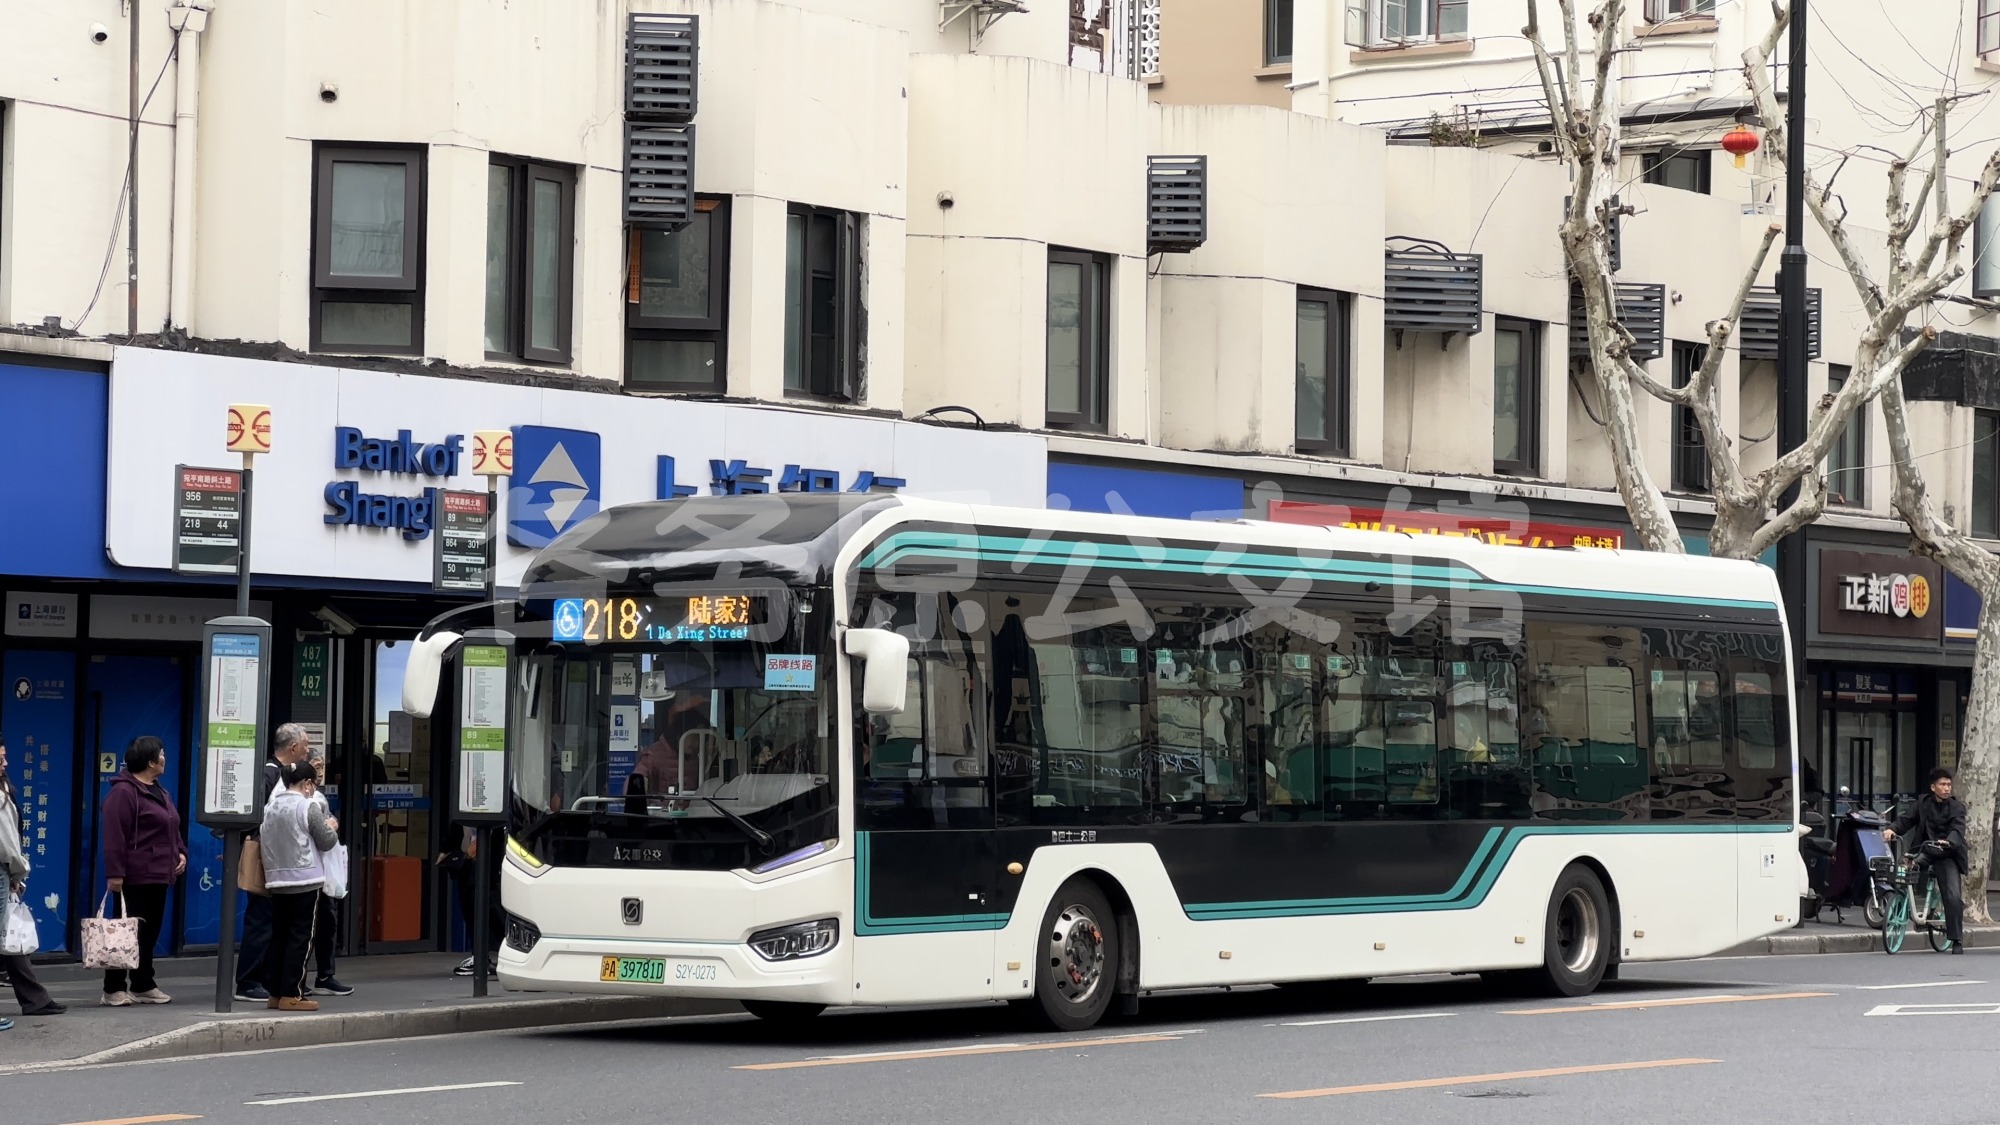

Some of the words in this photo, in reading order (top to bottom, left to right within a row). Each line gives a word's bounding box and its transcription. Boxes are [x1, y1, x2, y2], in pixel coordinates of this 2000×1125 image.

[335, 426, 424, 474] Bank
[421, 434, 464, 477] of
[183, 474, 231, 484] 宛平南路斜土路
[185, 491, 201, 501] 956
[323, 481, 438, 541] Shang
[184, 518, 200, 528] 218
[216, 520, 229, 530] 44
[447, 513, 456, 523] 89
[467, 540, 480, 550] 301
[447, 564, 456, 573] 50
[1841, 573, 1928, 615] 正新鸡排
[34, 604, 66, 615] 上海银行
[582, 598, 638, 640] 218
[657, 626, 672, 640] Da
[676, 626, 704, 642] Xing
[709, 626, 748, 640] Street
[302, 646, 321, 661] 487
[768, 658, 813, 671] 品牌线路
[301, 675, 321, 690] 487
[217, 727, 229, 735] 44
[467, 731, 477, 739] 89
[22, 735, 34, 882] 共赴财富花开的
[675, 964, 717, 981] S2Y-0273
